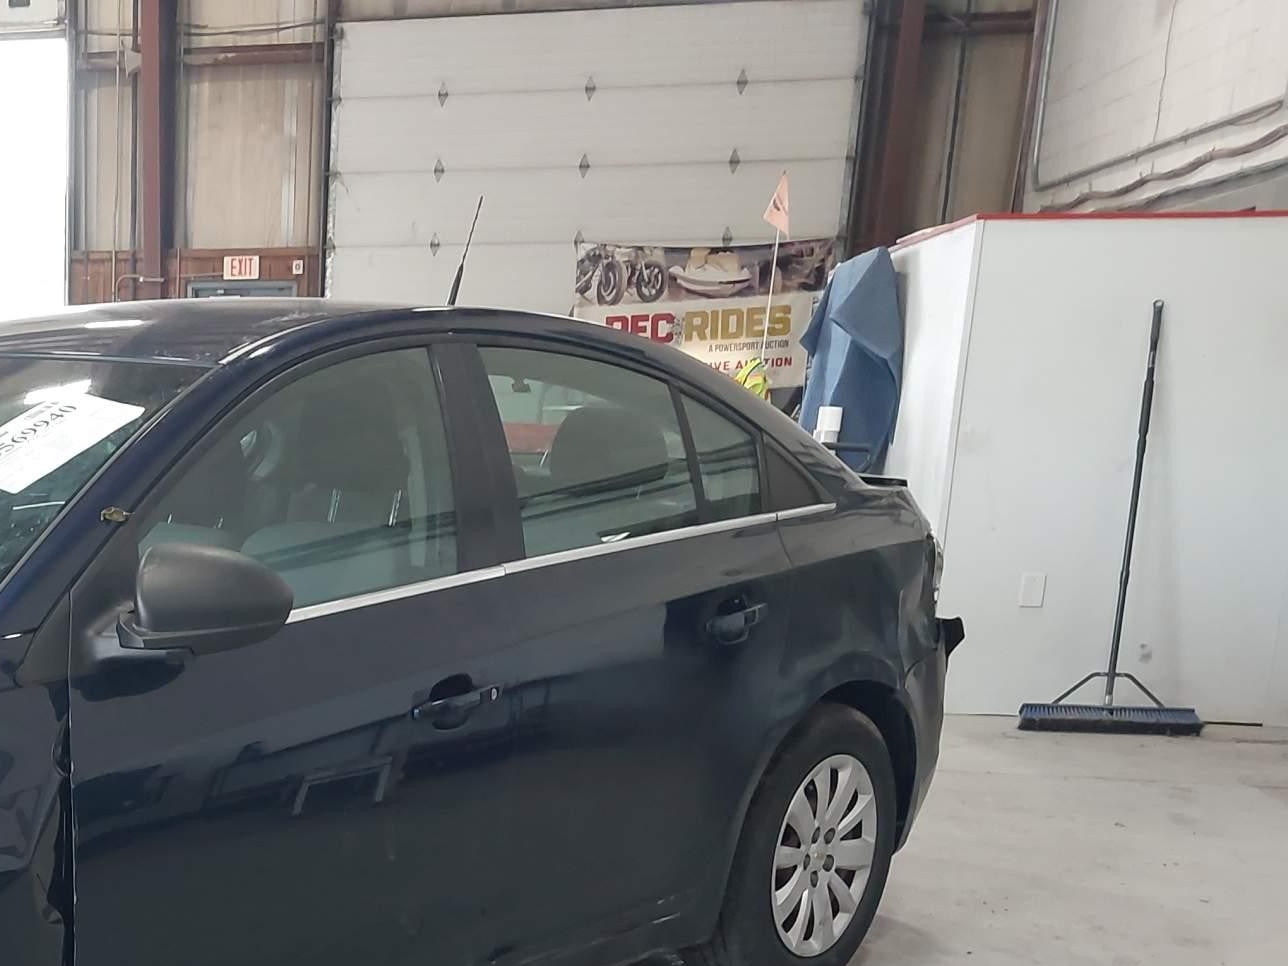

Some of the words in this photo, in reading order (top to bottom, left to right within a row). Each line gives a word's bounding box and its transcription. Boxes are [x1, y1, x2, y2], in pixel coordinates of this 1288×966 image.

[231, 258, 254, 276] EXIT
[685, 305, 792, 342] RIDES
[715, 341, 760, 352] POWERSPORT
